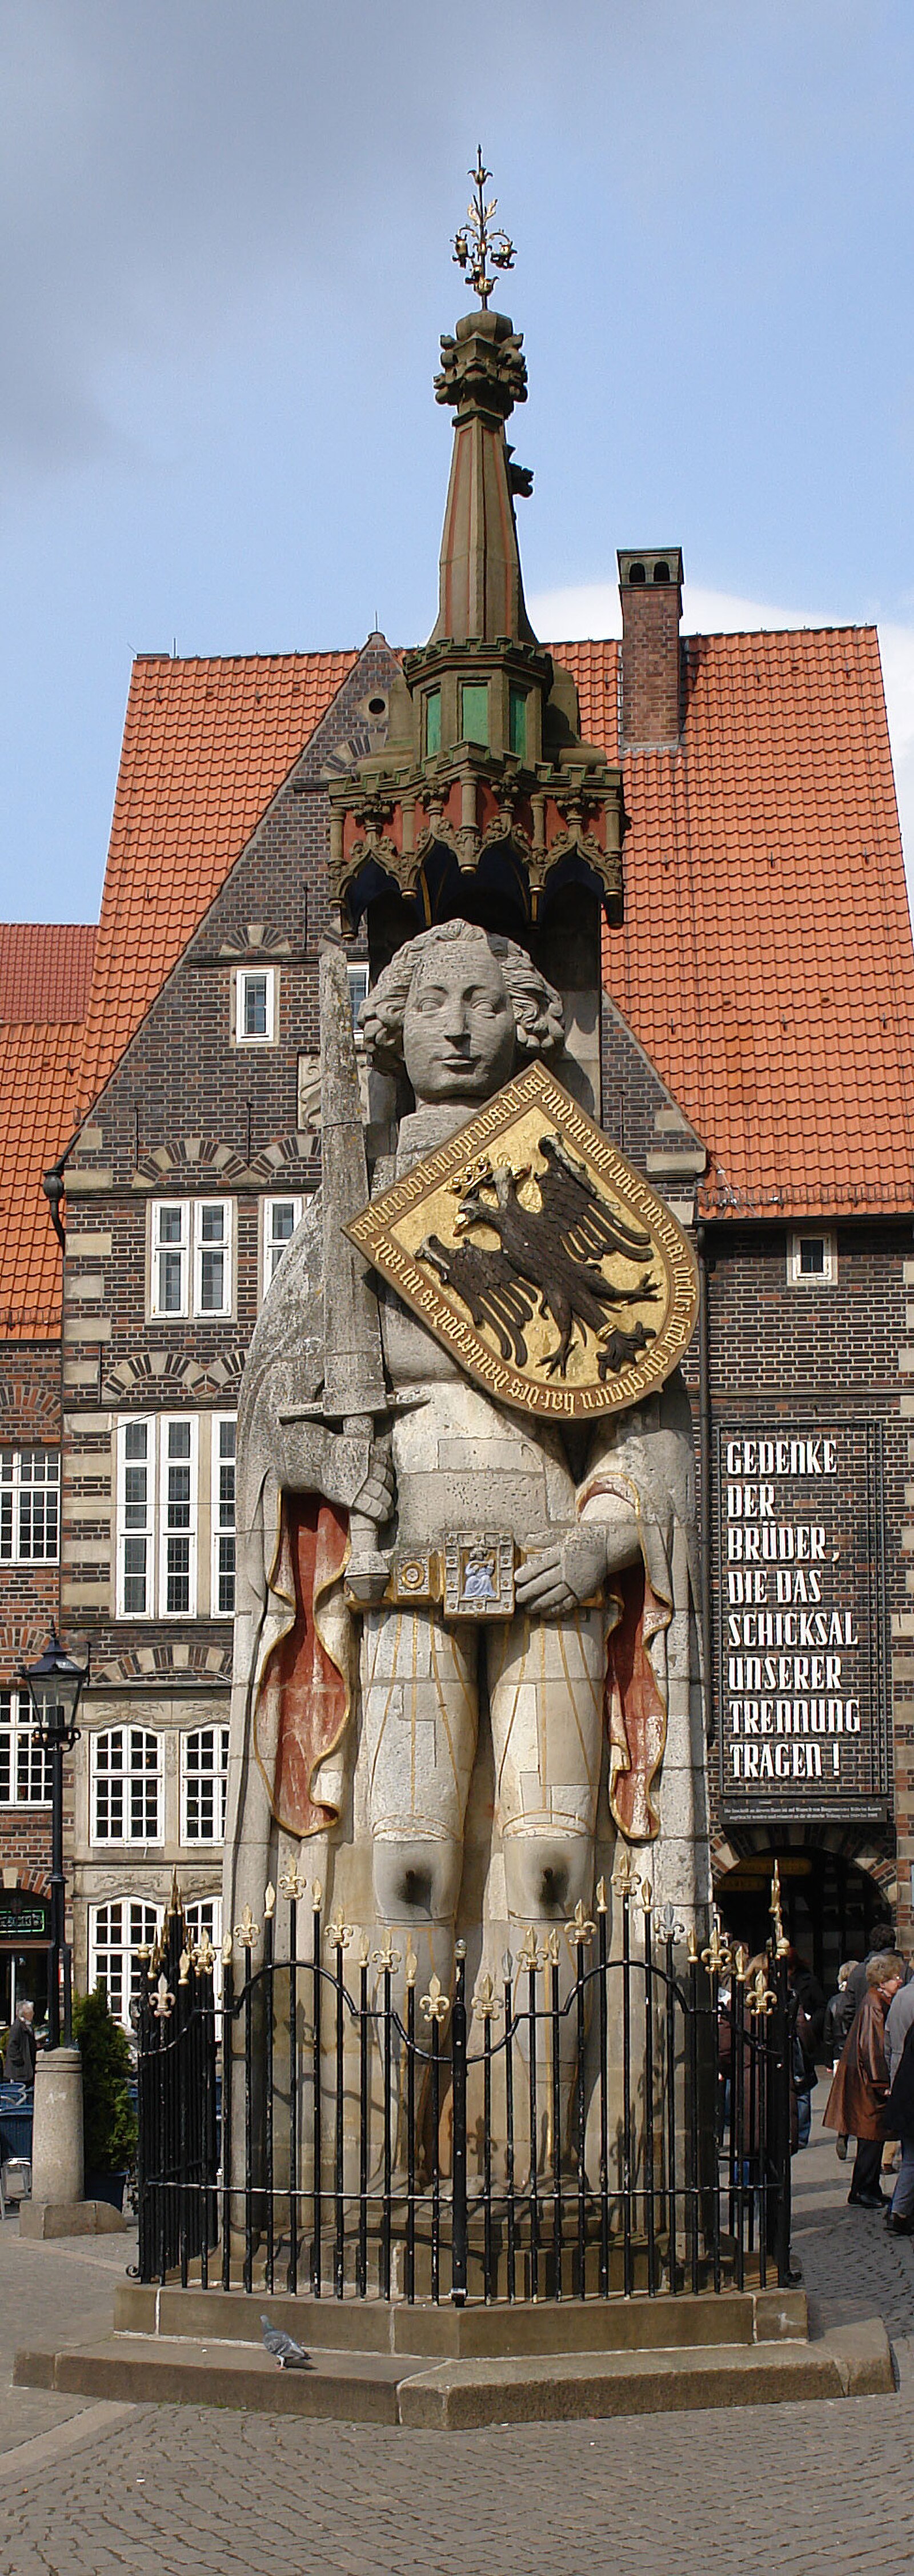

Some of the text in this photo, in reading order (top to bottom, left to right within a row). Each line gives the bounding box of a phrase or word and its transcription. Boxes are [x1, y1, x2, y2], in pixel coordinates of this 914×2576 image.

[727, 1440, 837, 1475] GEDENKE
[727, 1484, 775, 1517] DER
[728, 1569, 821, 1604] DIE DAS
[728, 1612, 859, 1646] SCHICKSAL
[728, 1656, 842, 1690] UNSERER
[729, 1698, 861, 1734] TRENNUNG
[729, 1743, 823, 1777] TRAGEN
